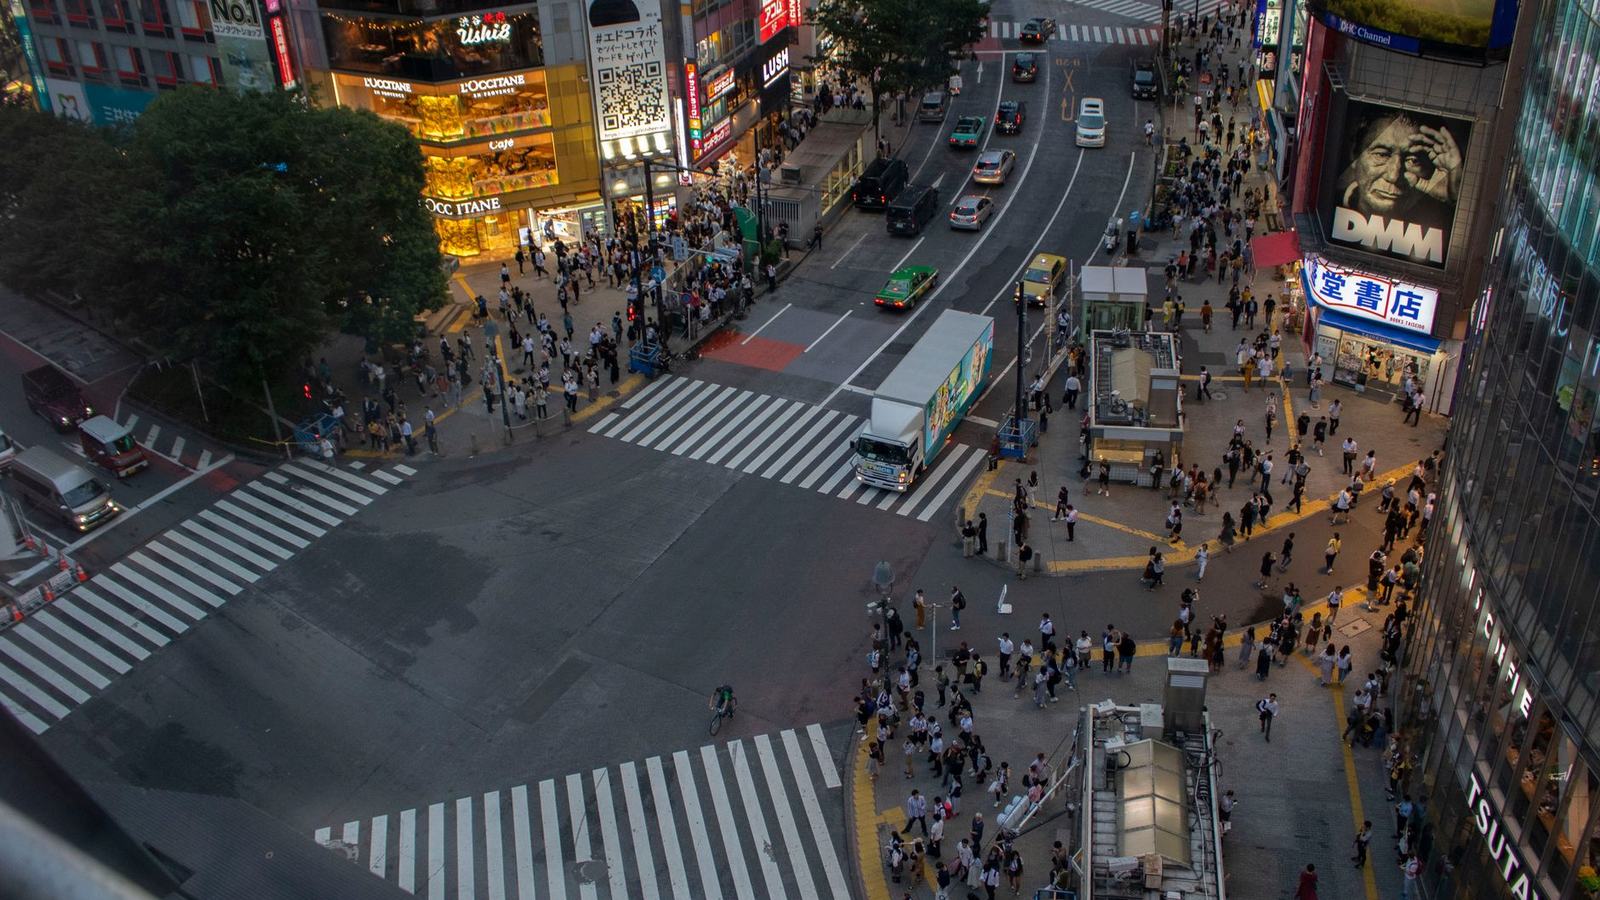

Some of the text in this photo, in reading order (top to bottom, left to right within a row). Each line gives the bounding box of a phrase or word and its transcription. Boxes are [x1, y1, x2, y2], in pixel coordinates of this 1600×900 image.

[596, 25, 657, 43] #エドコラボ
[1358, 26, 1391, 45] Channel
[763, 47, 789, 81] LUSH
[460, 75, 525, 93] L'OCCITANE
[489, 138, 514, 150] Café
[1331, 206, 1443, 264] DMM
[1468, 772, 1540, 900] TSUTA
